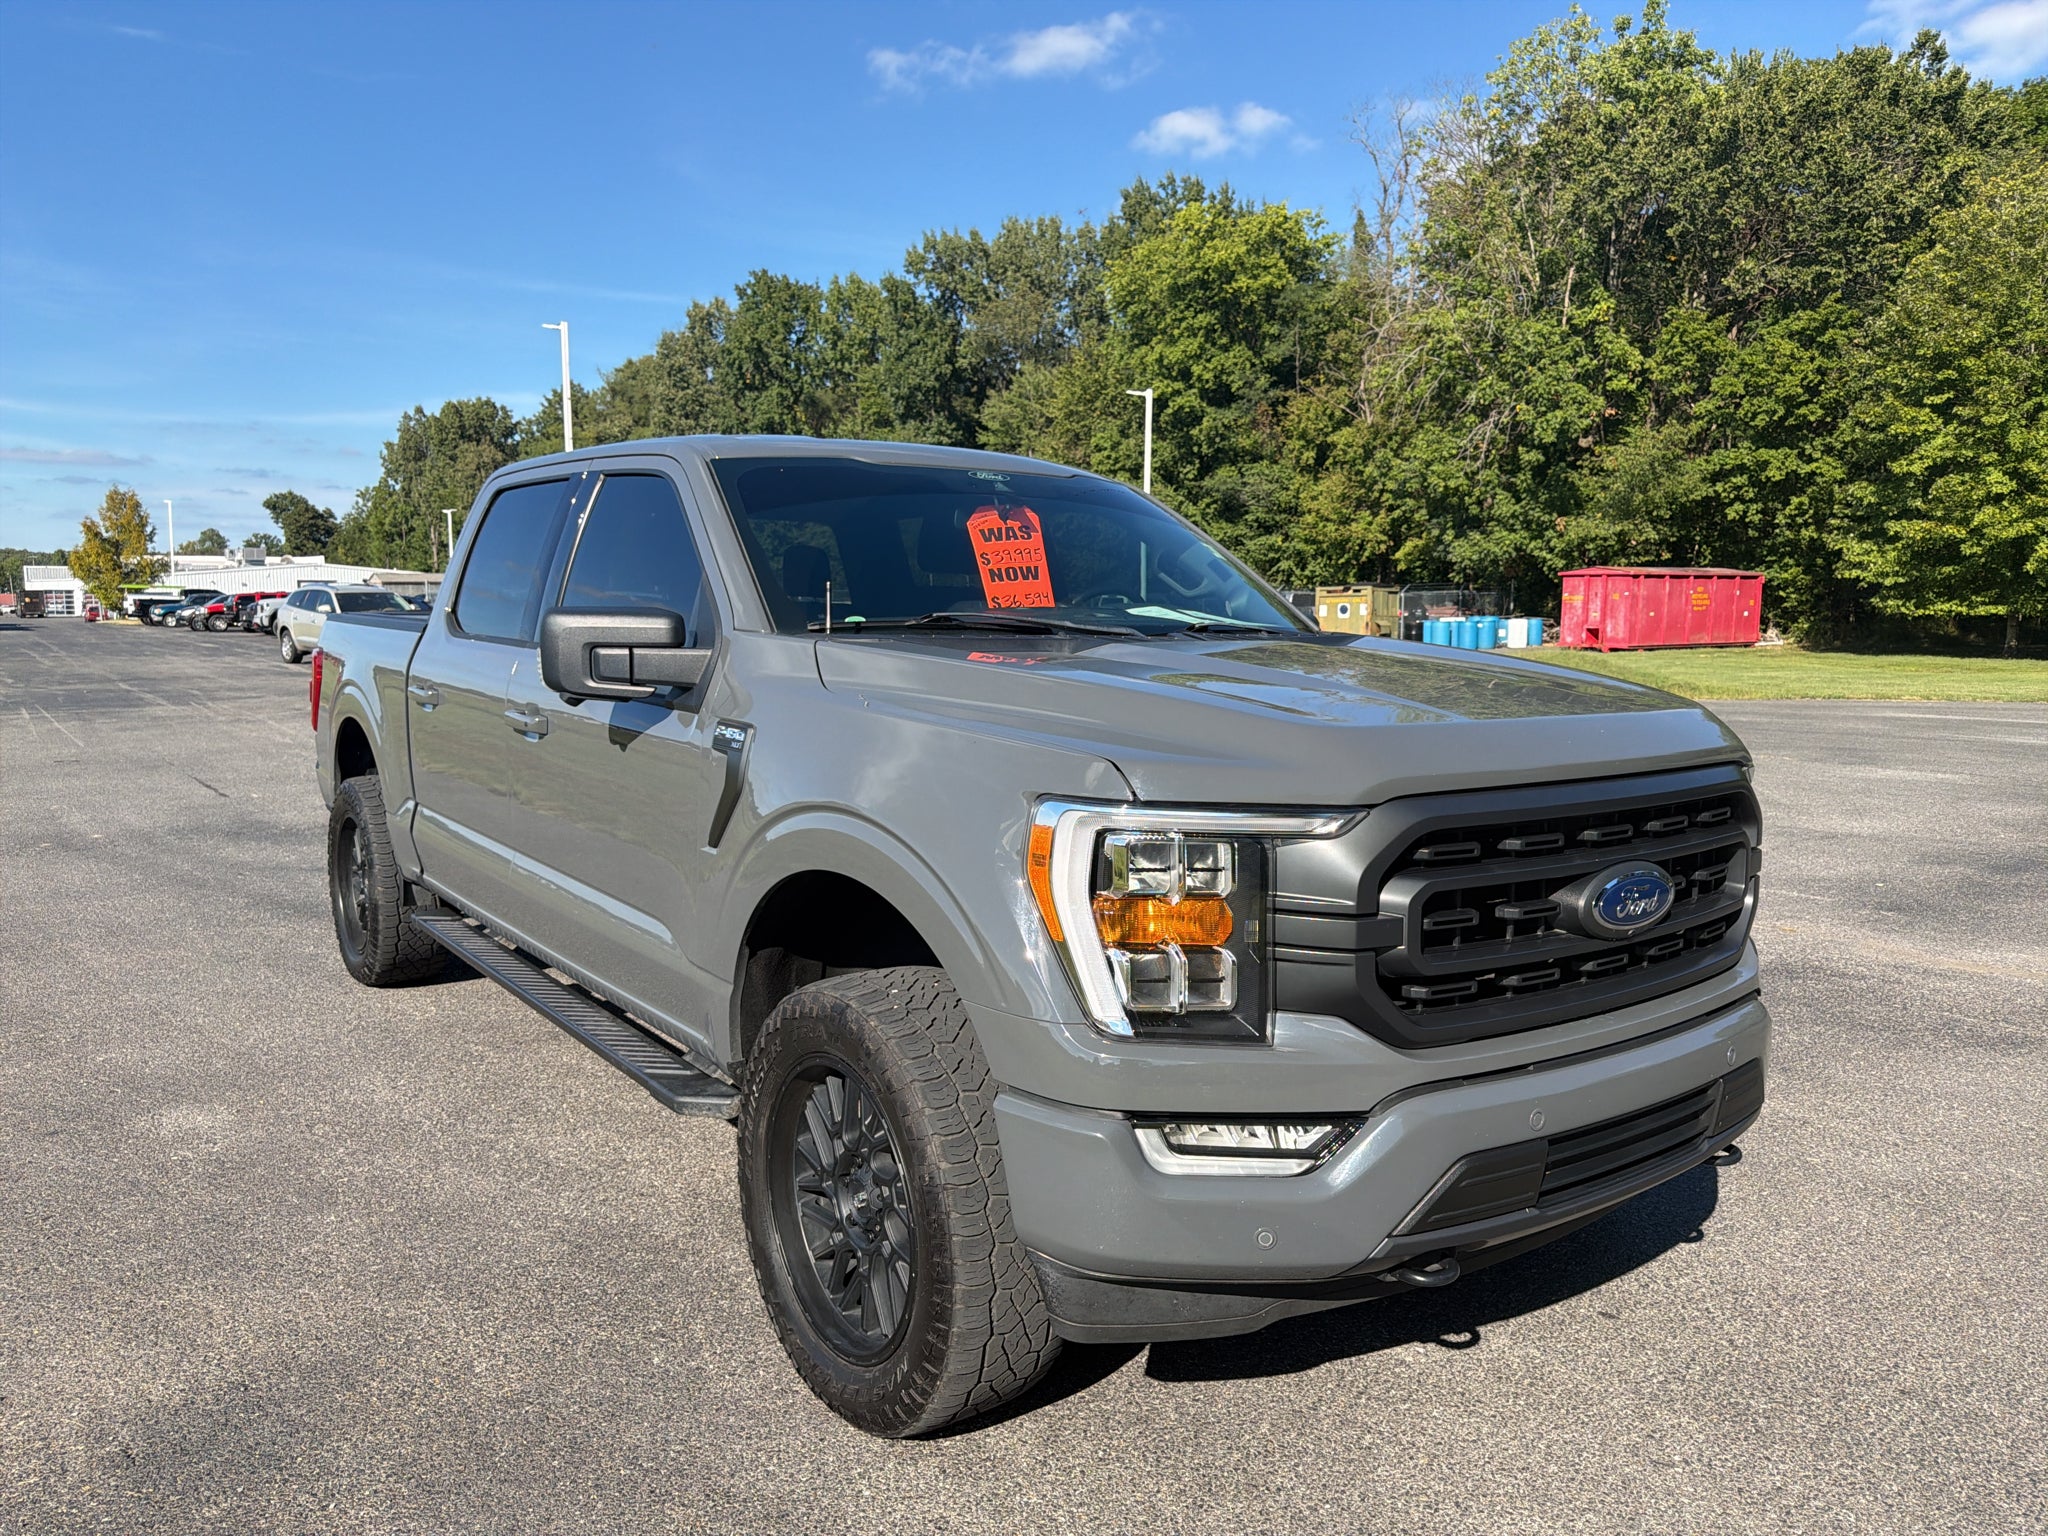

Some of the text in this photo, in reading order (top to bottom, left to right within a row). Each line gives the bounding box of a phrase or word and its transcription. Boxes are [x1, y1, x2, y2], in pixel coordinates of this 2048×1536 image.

[979, 525, 1033, 543] WAS
[980, 547, 1043, 567] $39,995
[988, 565, 1040, 583] NOW
[991, 592, 1051, 609] $36,594
[1615, 883, 1662, 919] Ford
